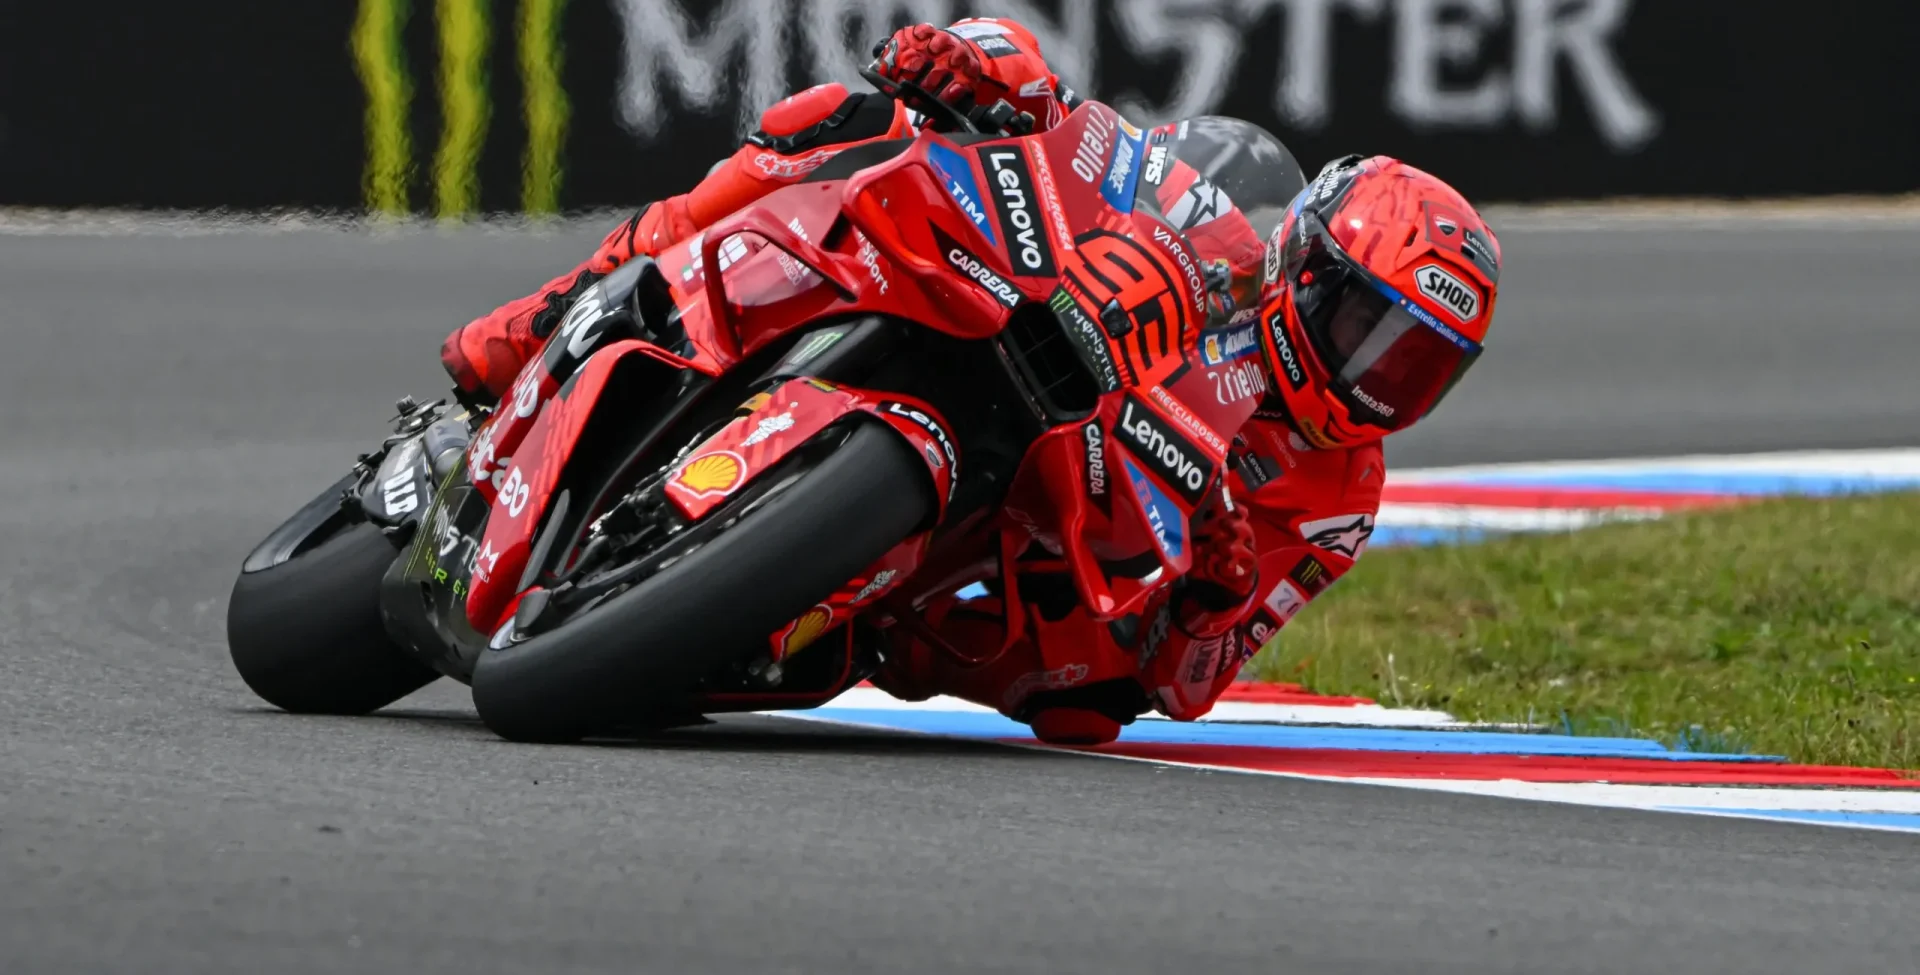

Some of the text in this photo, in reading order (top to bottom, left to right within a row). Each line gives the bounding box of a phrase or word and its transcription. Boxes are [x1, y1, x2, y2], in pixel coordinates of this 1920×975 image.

[952, 181, 985, 225] TIM
[990, 152, 1042, 269] Lenovo
[948, 248, 1020, 308] CARRERA
[1153, 226, 1205, 313] VARGROUP
[1425, 271, 1475, 316] SHOEI
[1074, 228, 1192, 388] 93
[1407, 304, 1436, 329] Estrella
[1070, 308, 1116, 391] MONSTER
[1271, 314, 1300, 381] Lenovo
[1151, 386, 1225, 455] FRECCIAROSSA
[1351, 385, 1395, 418] Insta360
[1086, 423, 1105, 495] CARRERA
[1122, 402, 1203, 491] Lenovo
[1148, 504, 1170, 551] TIM
